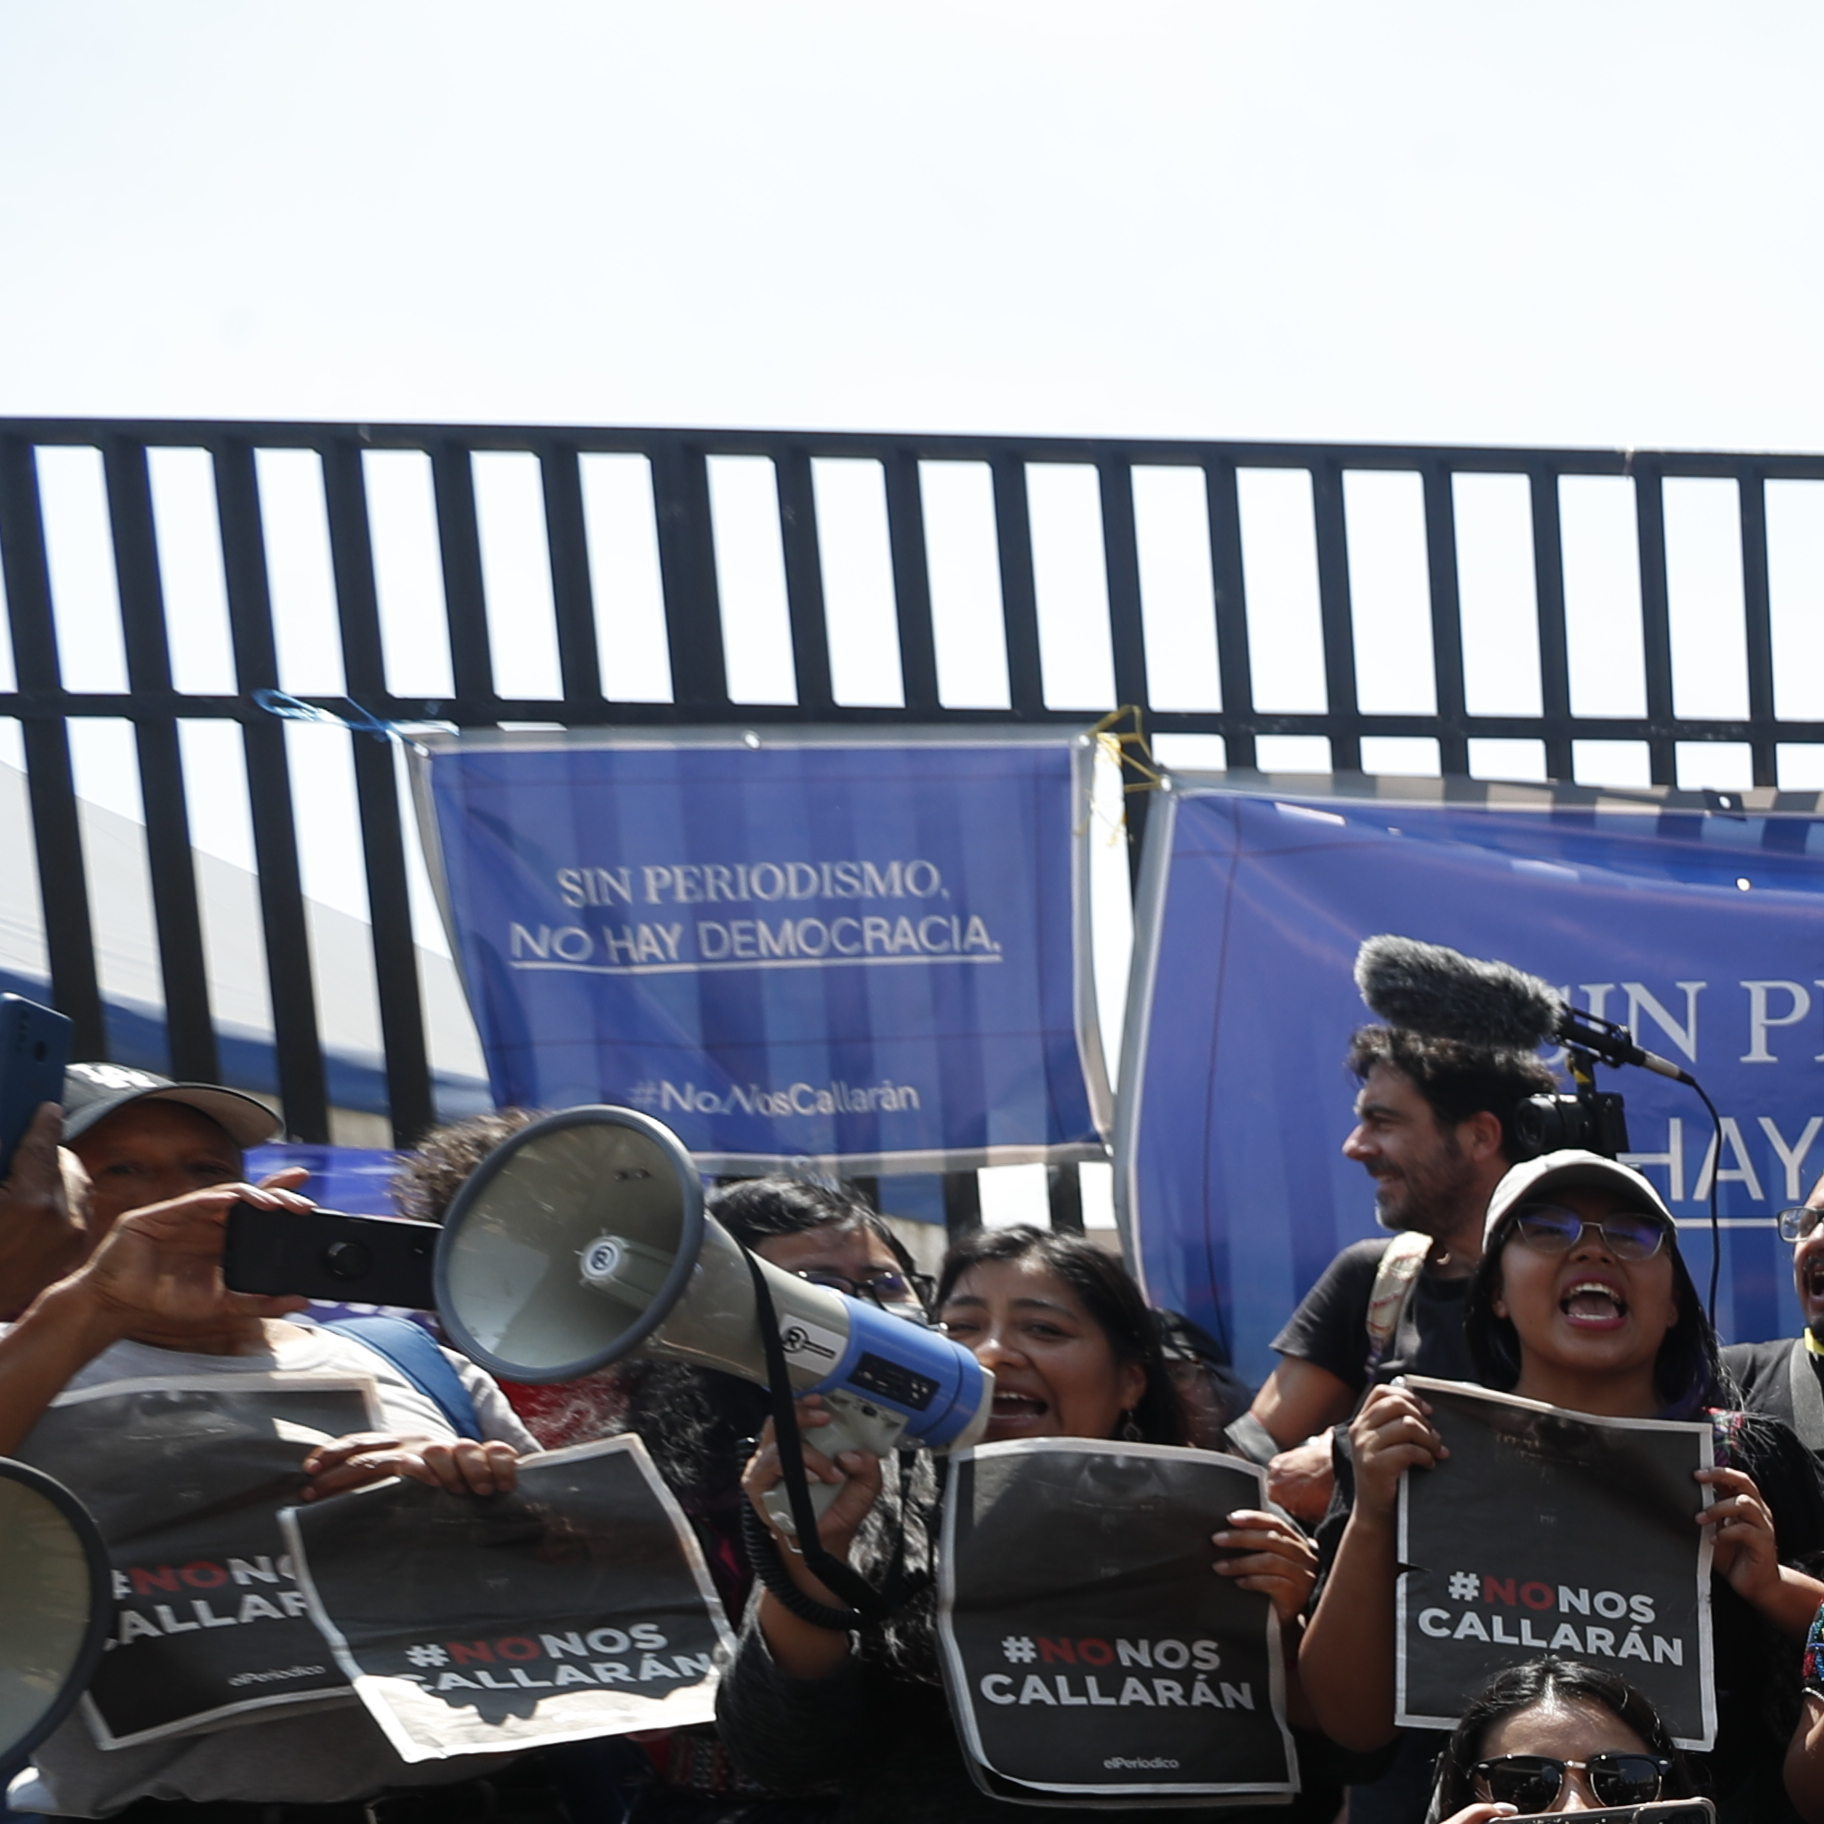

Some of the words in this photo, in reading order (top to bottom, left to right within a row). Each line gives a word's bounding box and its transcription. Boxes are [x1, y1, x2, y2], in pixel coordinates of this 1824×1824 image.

[557, 863, 632, 907] SIN
[511, 922, 592, 961] NO
[605, 922, 684, 965] HAY
[701, 915, 1001, 959] DEMOCRACIA.
[1448, 1571, 1655, 1623] #NONOS
[408, 1623, 667, 1669] #NONOS
[1002, 1638, 1221, 1672] #NONOS
[1418, 1608, 1683, 1666] CALLARÁN
[981, 1674, 1255, 1710] CALLARÁN
[1104, 1756, 1179, 1771] elPeriodico
